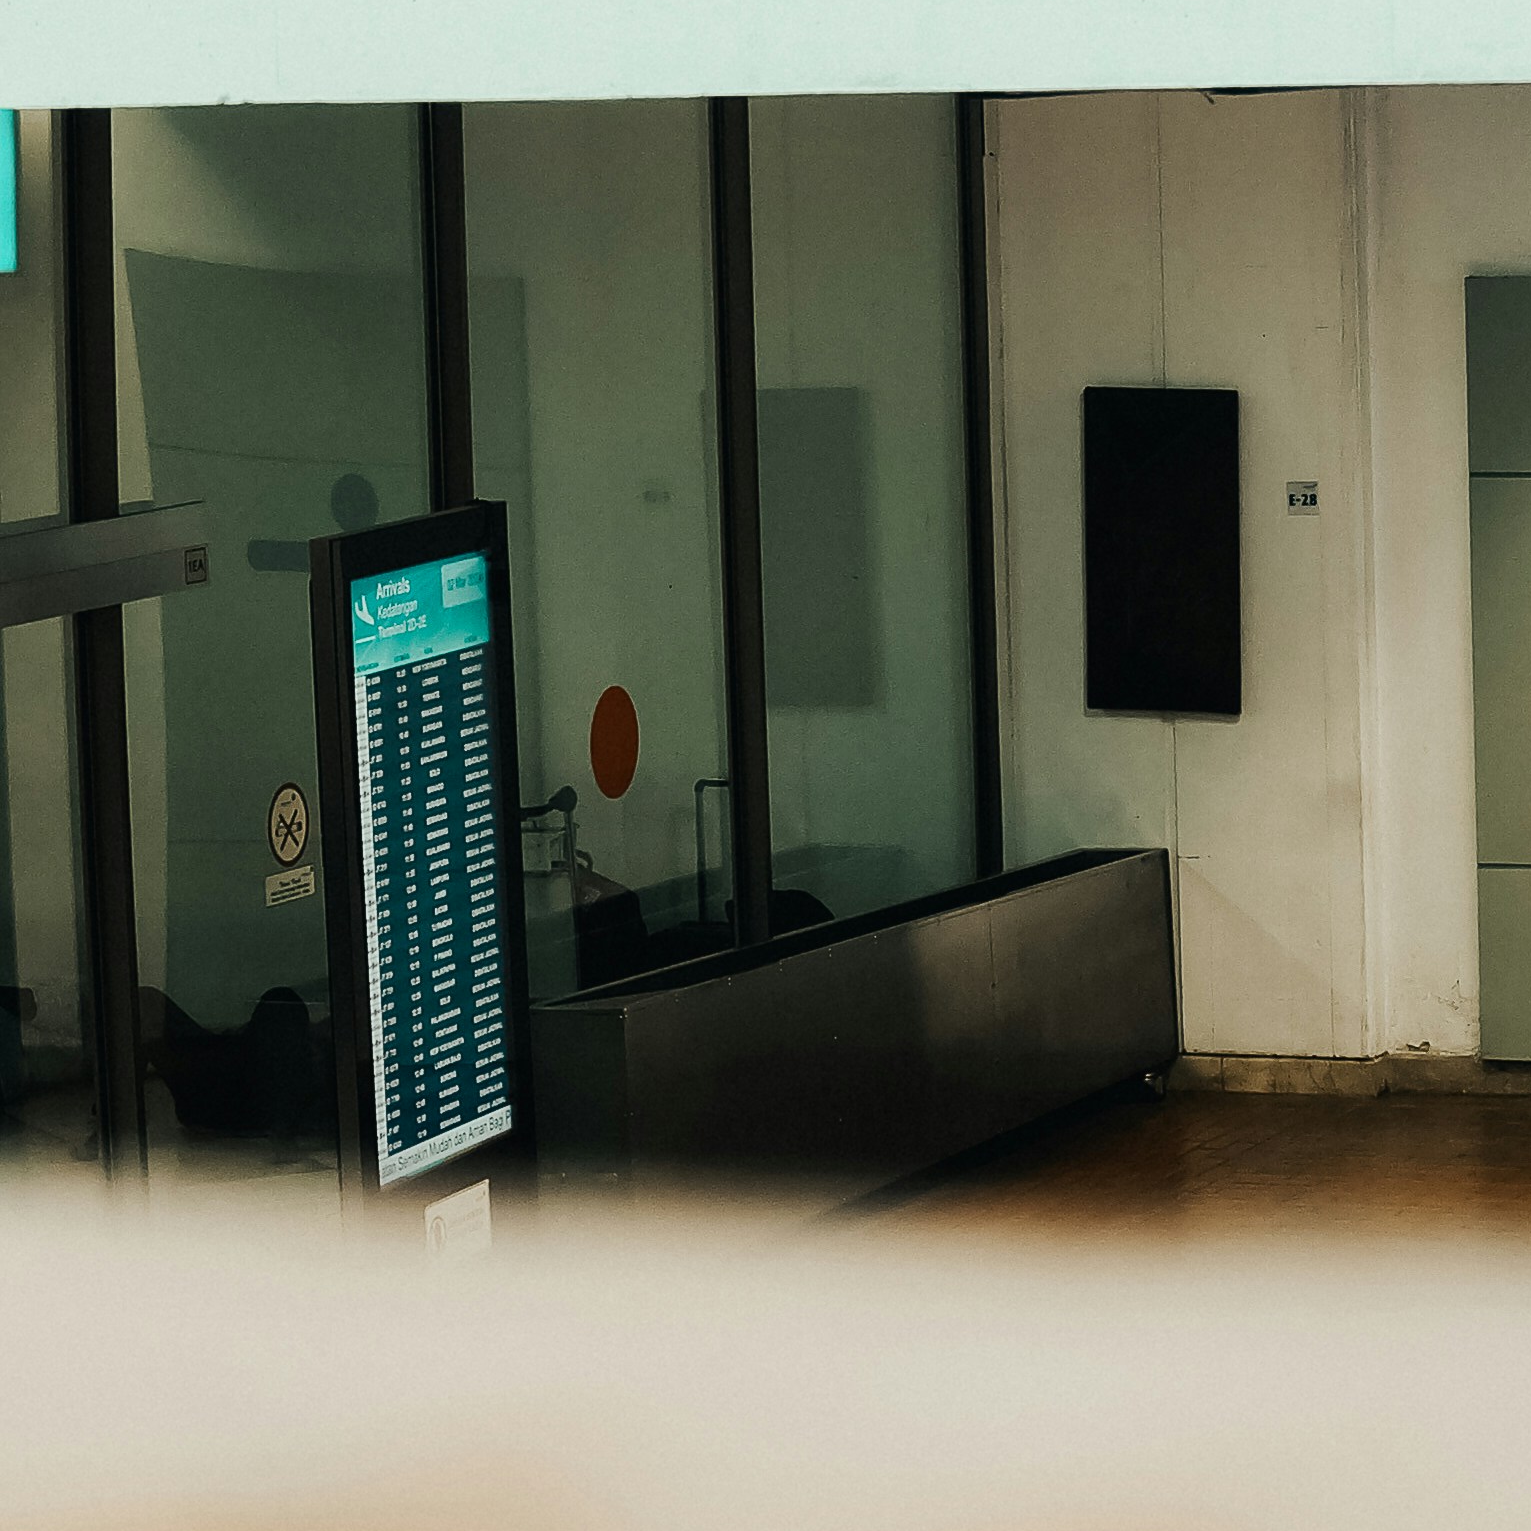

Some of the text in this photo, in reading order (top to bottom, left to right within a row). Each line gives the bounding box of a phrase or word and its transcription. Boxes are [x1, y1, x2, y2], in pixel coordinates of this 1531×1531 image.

[1289, 493, 1318, 506] E-28
[376, 576, 411, 600] Arrivals
[377, 599, 418, 620] Kedatangan
[428, 1136, 453, 1156] Mudah
[467, 1122, 488, 1140] Aman
[488, 1113, 504, 1132] Bagi
